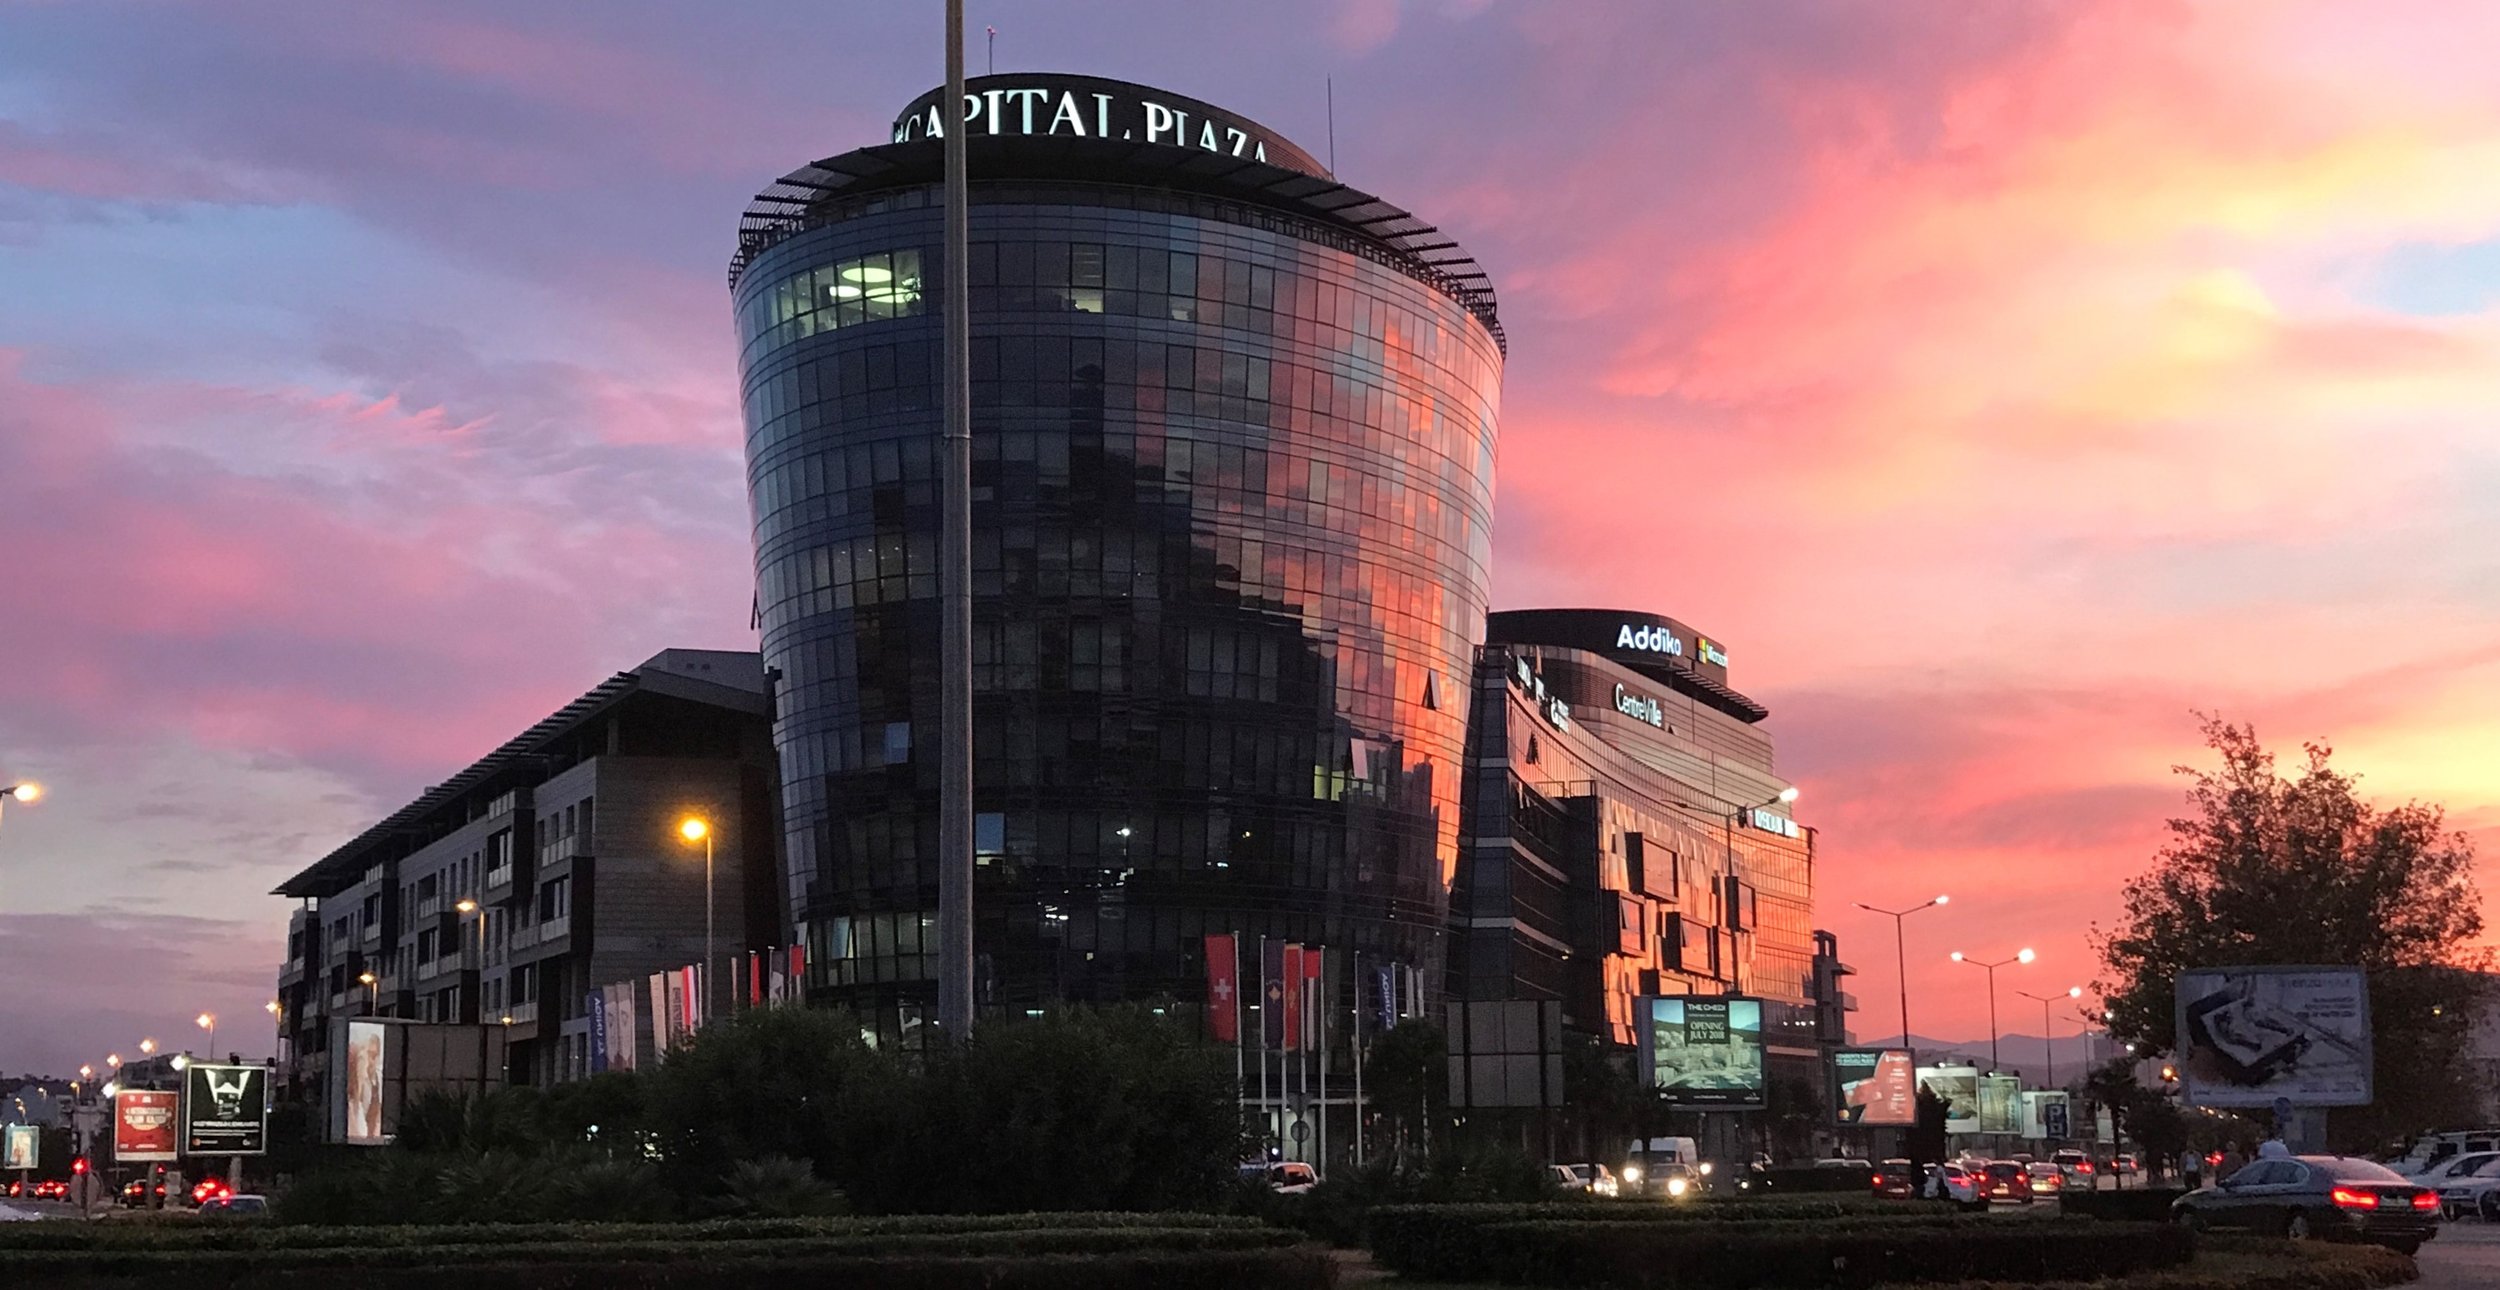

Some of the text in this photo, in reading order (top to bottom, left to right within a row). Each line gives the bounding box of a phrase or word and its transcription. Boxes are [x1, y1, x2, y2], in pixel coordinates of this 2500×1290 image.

[1617, 624, 1682, 656] Addiko
[1615, 682, 1662, 727] CentreVille
[1690, 1021, 1724, 1030] OPENING
[1690, 1031, 1707, 1040] JULY
